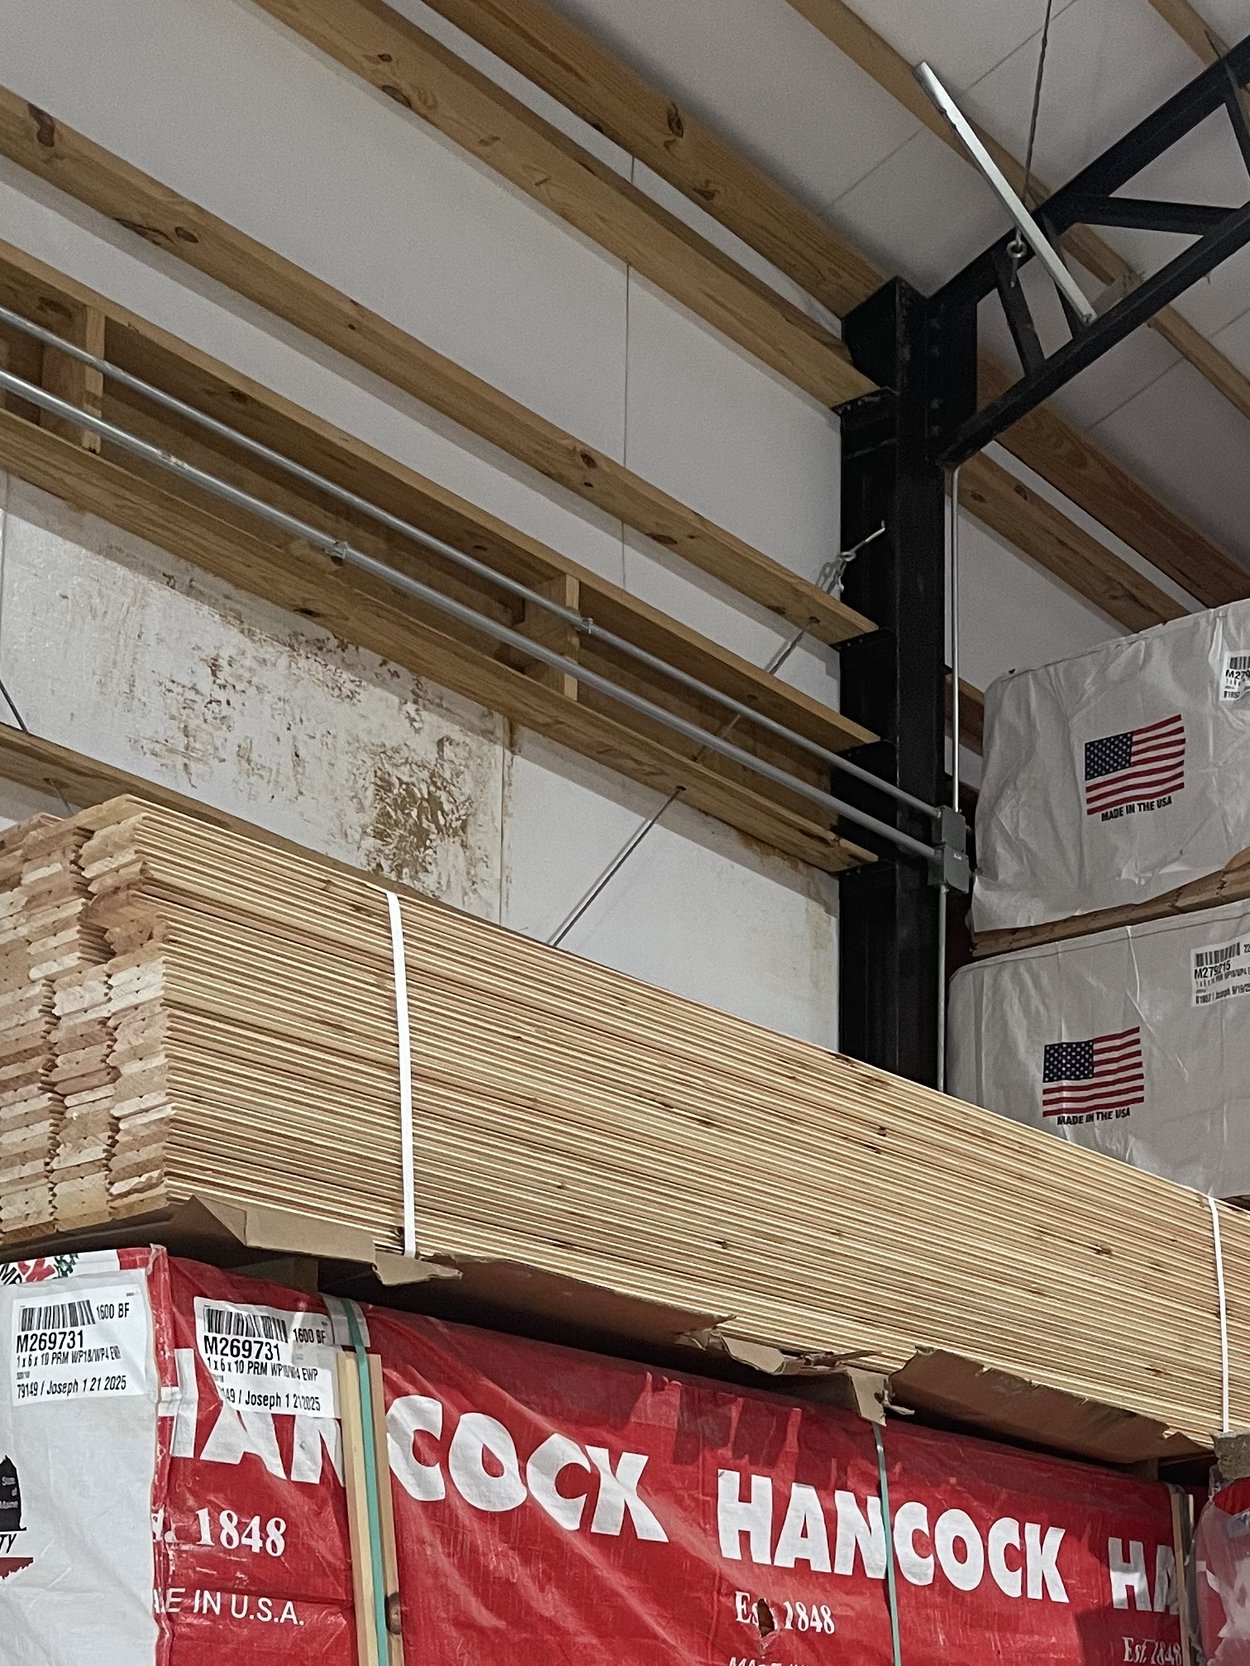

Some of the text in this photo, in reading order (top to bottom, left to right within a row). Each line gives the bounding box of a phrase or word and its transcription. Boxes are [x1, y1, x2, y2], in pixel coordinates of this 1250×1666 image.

[1101, 796, 1173, 823] MADE IN THE USA
[1194, 959, 1231, 980] M279215
[1057, 1106, 1131, 1127] MADE IN THE USA
[117, 1302, 130, 1319] BF
[16, 1329, 84, 1354] M269731
[203, 1334, 281, 1362] M269731
[51, 1350, 69, 1366] PRM
[219, 1358, 226, 1371] 6
[235, 1359, 245, 1375] 10
[247, 1359, 268, 1377] PRM
[302, 1366, 319, 1382] EWP
[46, 1380, 79, 1397] Joseph
[82, 1377, 88, 1393] 1
[90, 1376, 102, 1391] 21
[104, 1374, 127, 1391] 2025
[244, 1389, 282, 1411] Joseph
[285, 1393, 290, 1409] 1
[196, 1509, 287, 1558] 1848
[717, 1467, 1070, 1604] HANCOCK
[193, 1588, 222, 1616] IN
[230, 1597, 305, 1627] U.S.A.
[784, 1599, 836, 1635] 1848
